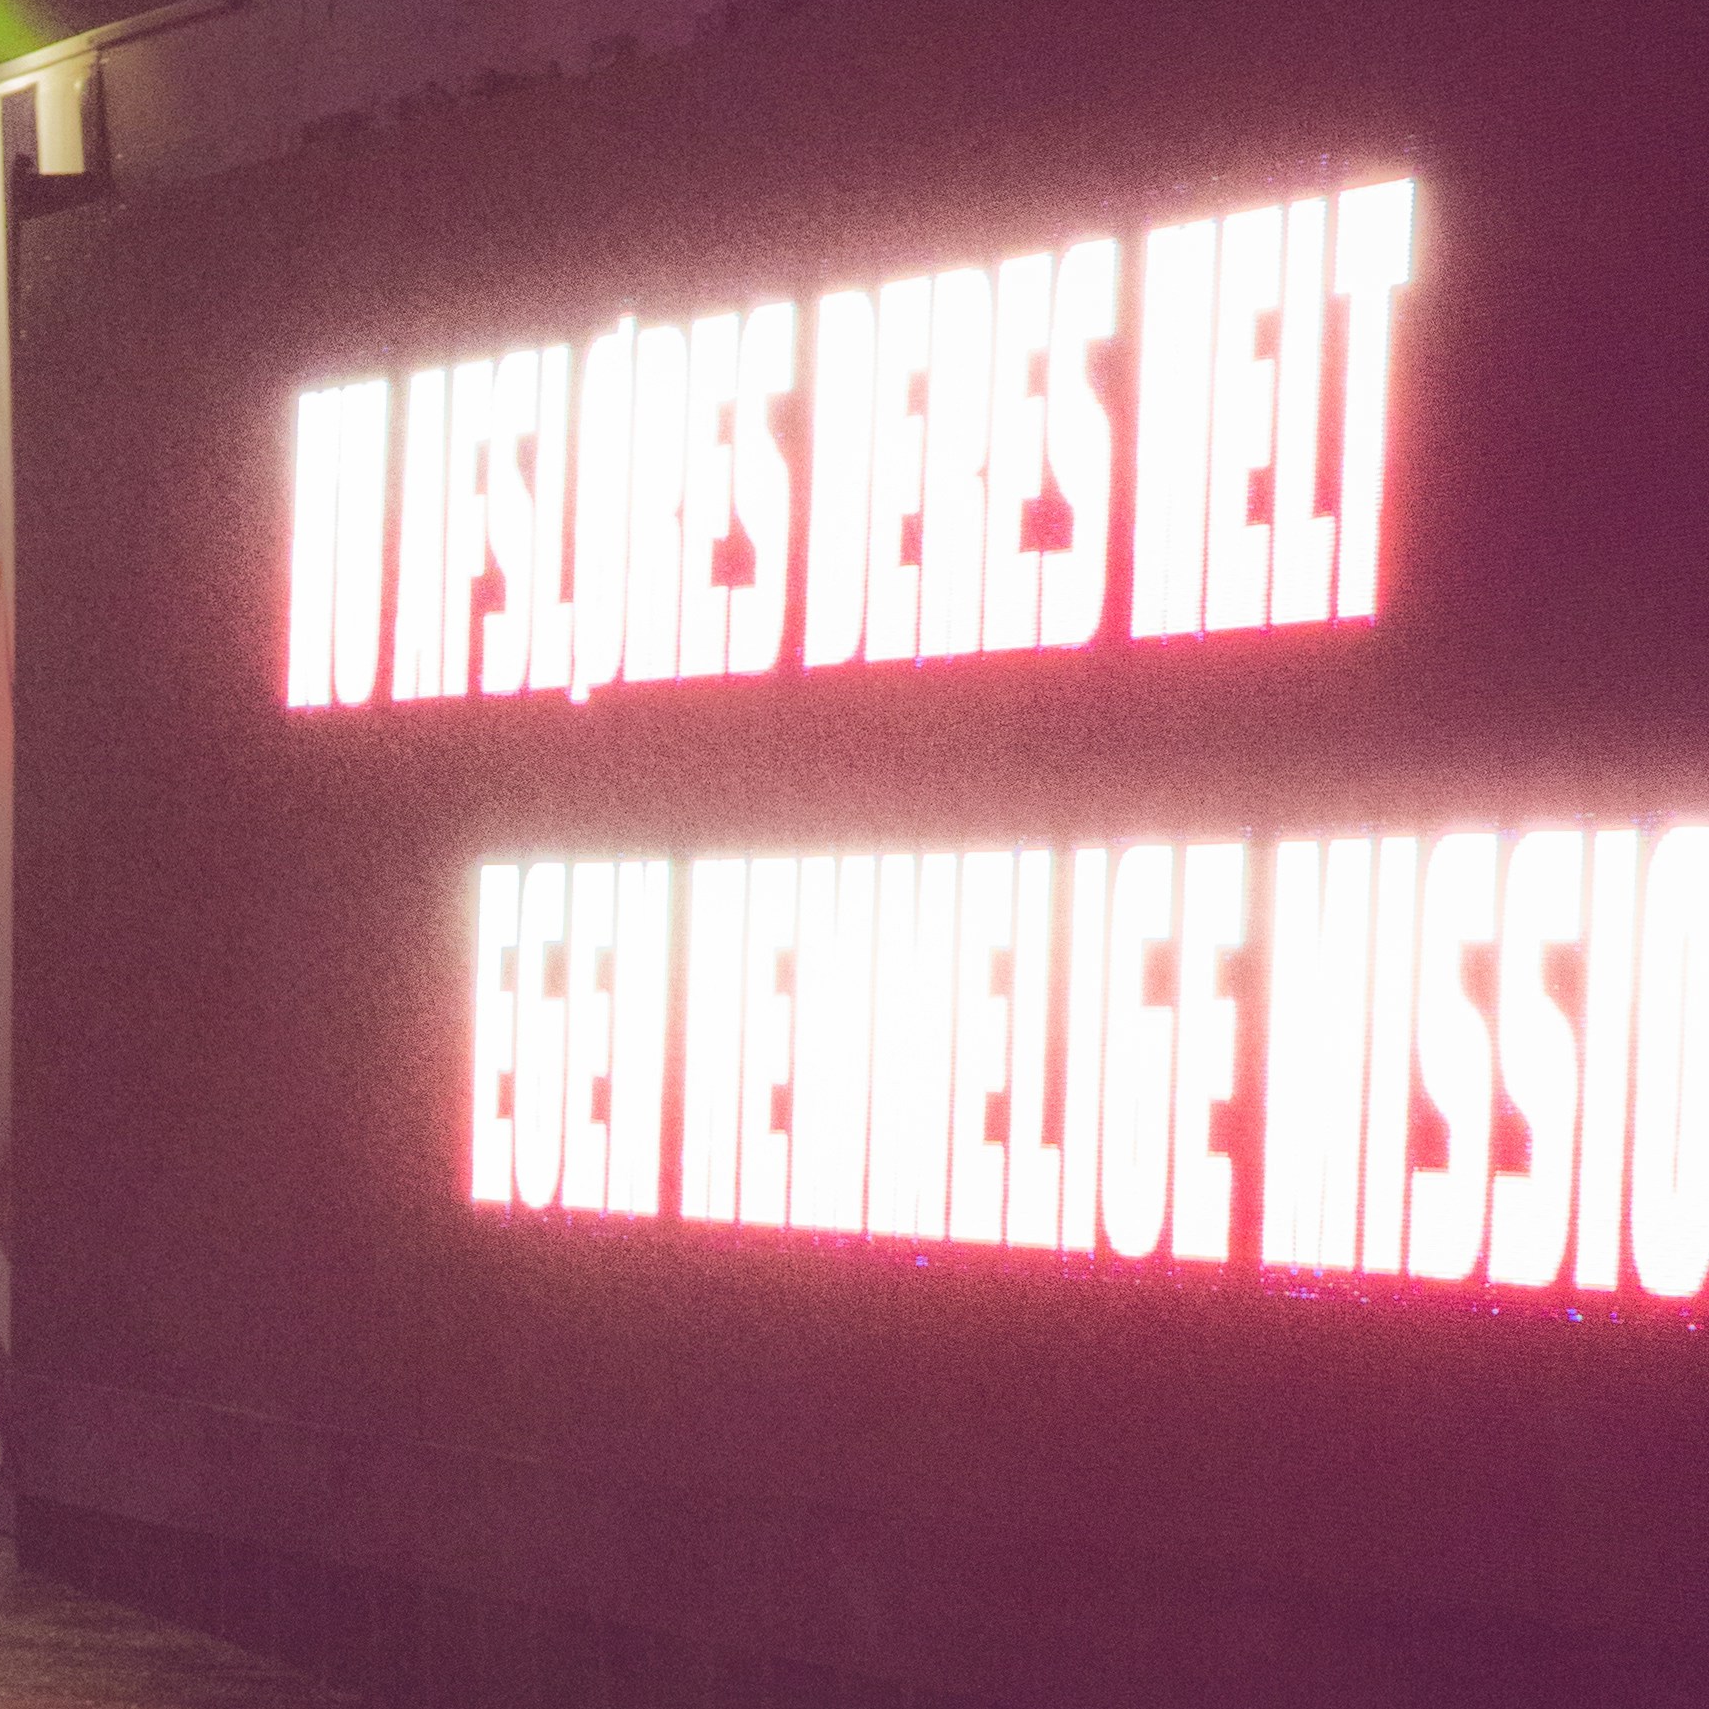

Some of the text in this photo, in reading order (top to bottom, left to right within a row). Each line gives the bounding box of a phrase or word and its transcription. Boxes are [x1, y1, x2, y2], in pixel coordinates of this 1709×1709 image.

[286, 379, 389, 706] NU
[803, 238, 1115, 666] DERES
[1131, 178, 1413, 637] HELT
[471, 858, 671, 1214] EGEN
[681, 842, 1245, 1259] HEMMELIGE
